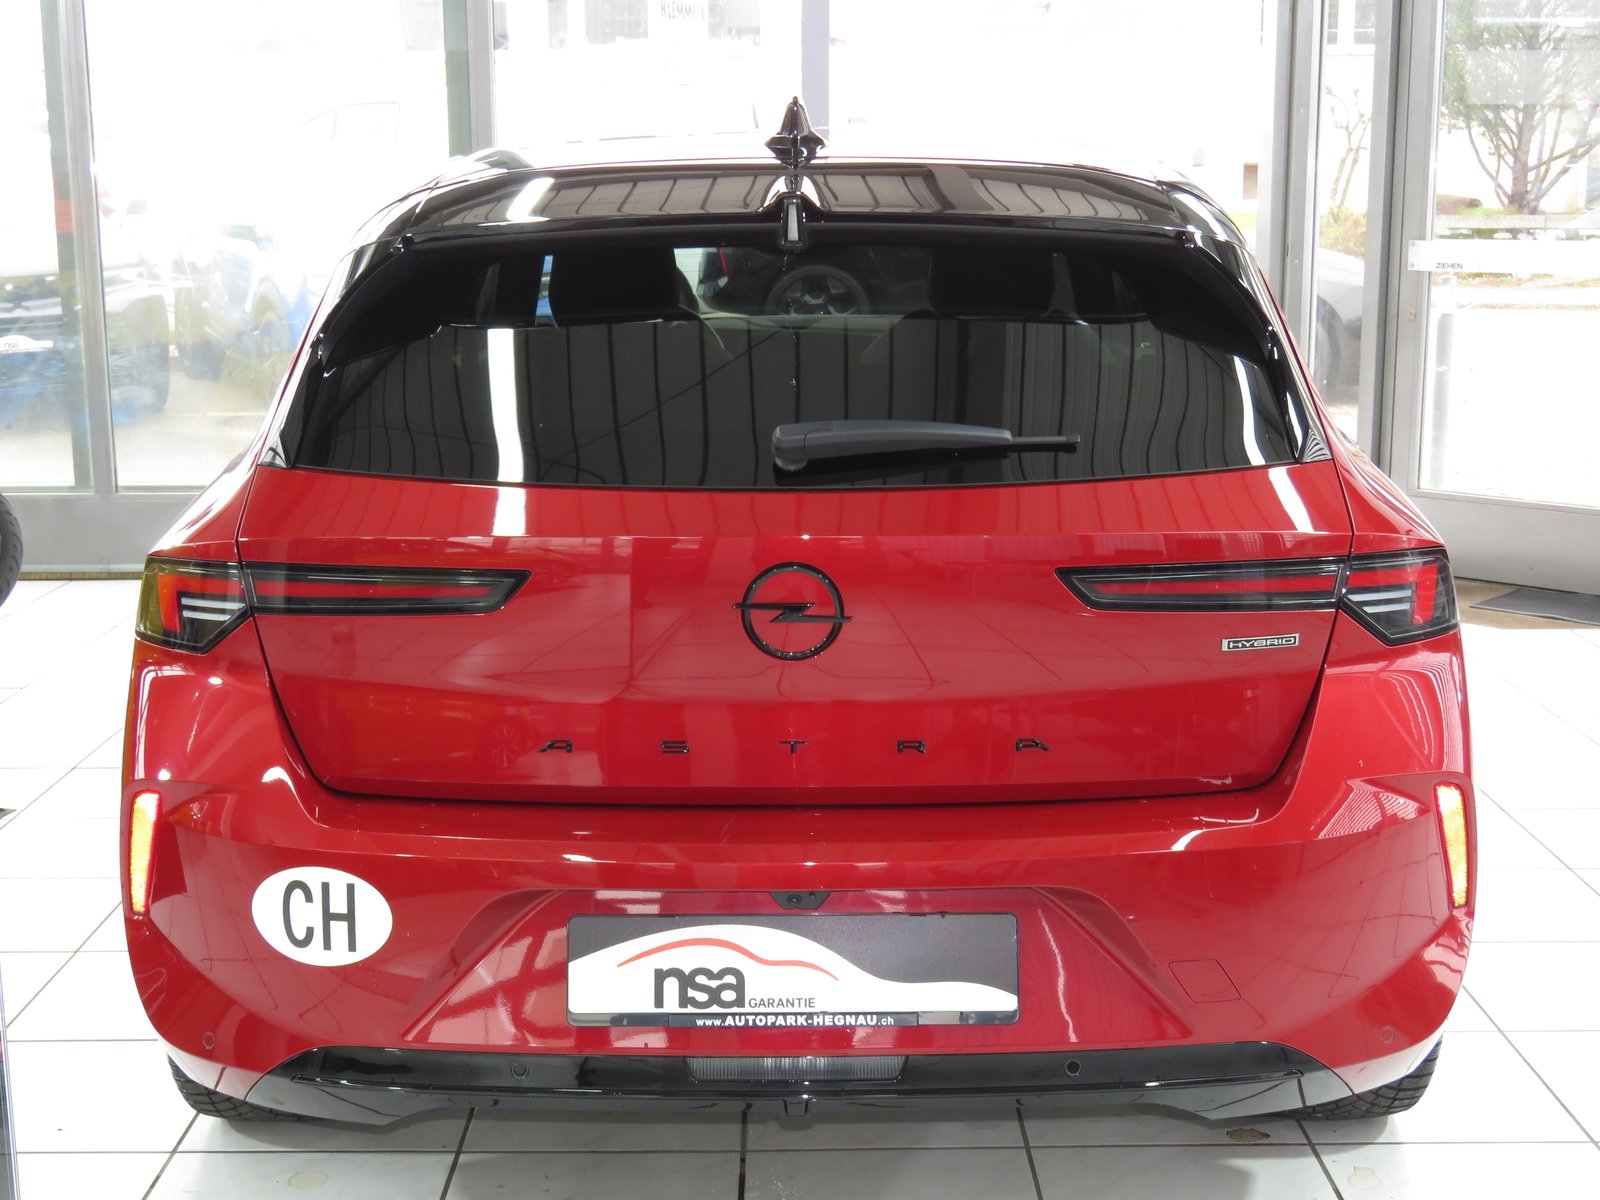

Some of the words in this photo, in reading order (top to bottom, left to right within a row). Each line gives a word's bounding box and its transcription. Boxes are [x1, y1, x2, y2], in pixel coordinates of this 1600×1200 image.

[1229, 637, 1295, 648] HYBRID
[538, 738, 1050, 754] ASTRA
[282, 879, 357, 953] CH
[653, 966, 746, 1010] nsa
[748, 997, 816, 1009] GARANTIE
[695, 1014, 895, 1028] www.AUTOPARK-HEGNAU.ch
